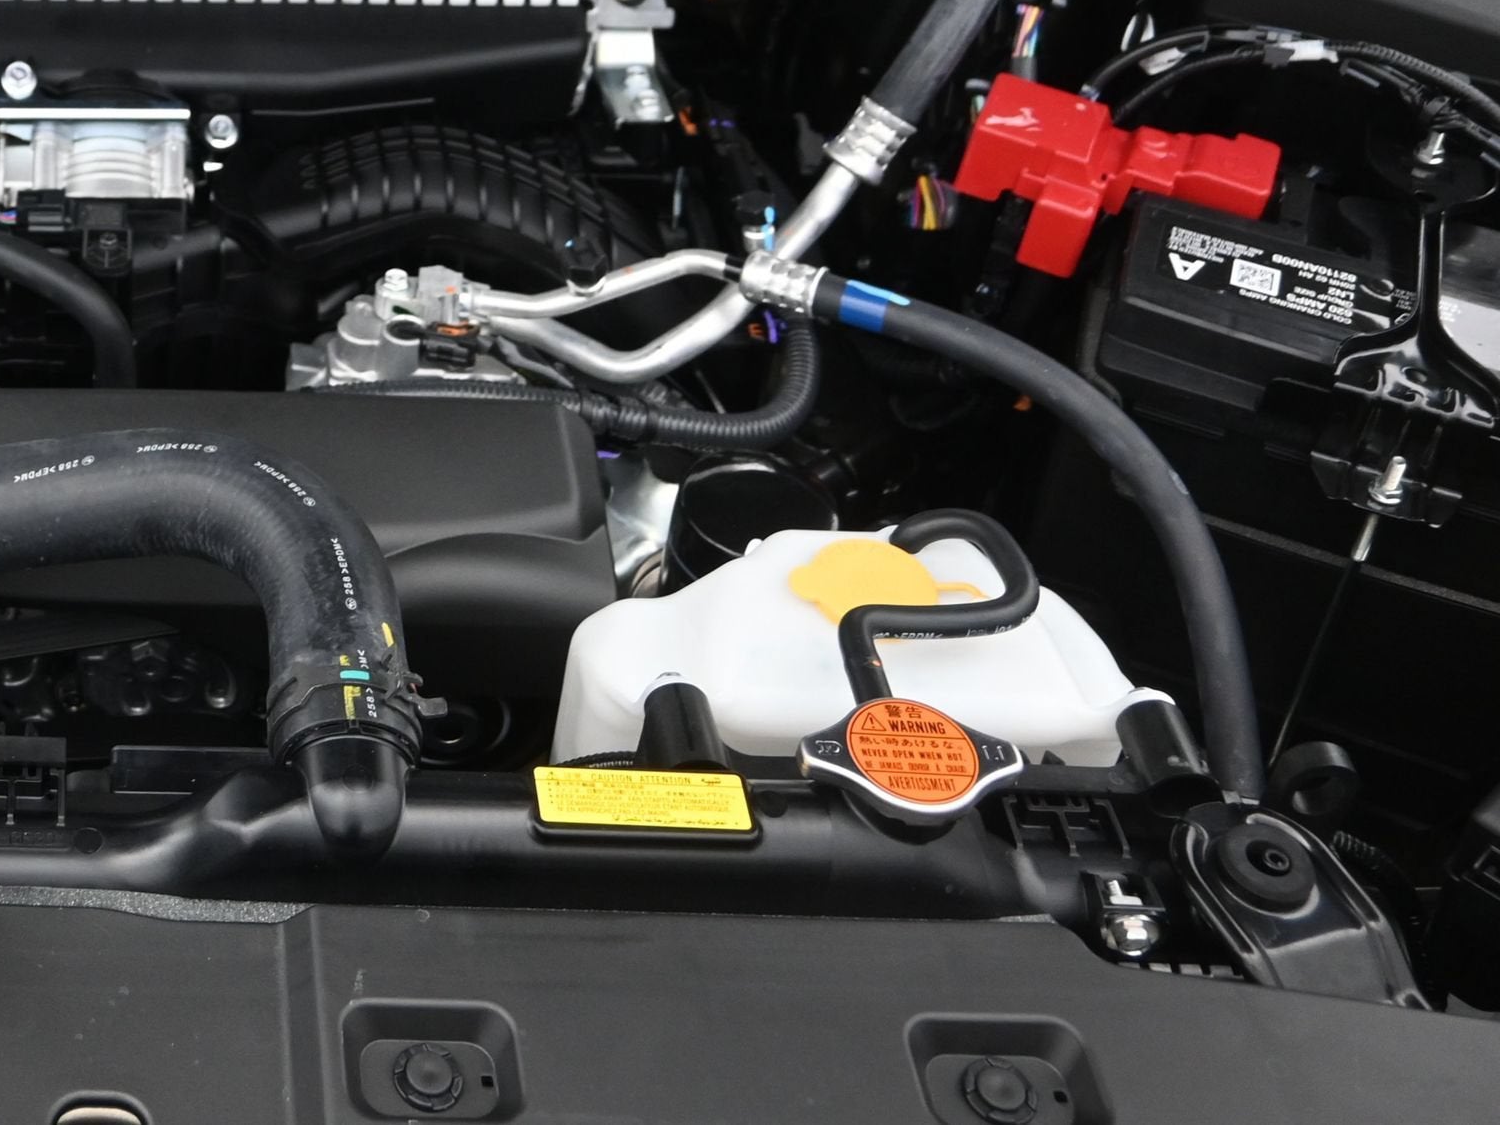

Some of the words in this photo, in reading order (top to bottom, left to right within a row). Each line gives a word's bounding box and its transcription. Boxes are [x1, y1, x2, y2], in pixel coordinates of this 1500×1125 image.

[1238, 288, 1268, 301] AMPS
[1286, 292, 1327, 310] AMPS
[1268, 296, 1322, 317] CRANKING
[342, 575, 354, 595] 258
[885, 704, 922, 719] 警告
[888, 719, 946, 735] WARNING
[861, 748, 888, 757] NEVER
[892, 749, 915, 759] OPEN
[919, 751, 943, 760] WHEN
[591, 773, 633, 782] CAUTION
[640, 775, 691, 785] ATTENTION
[888, 775, 956, 792] AVERTISSMENT
